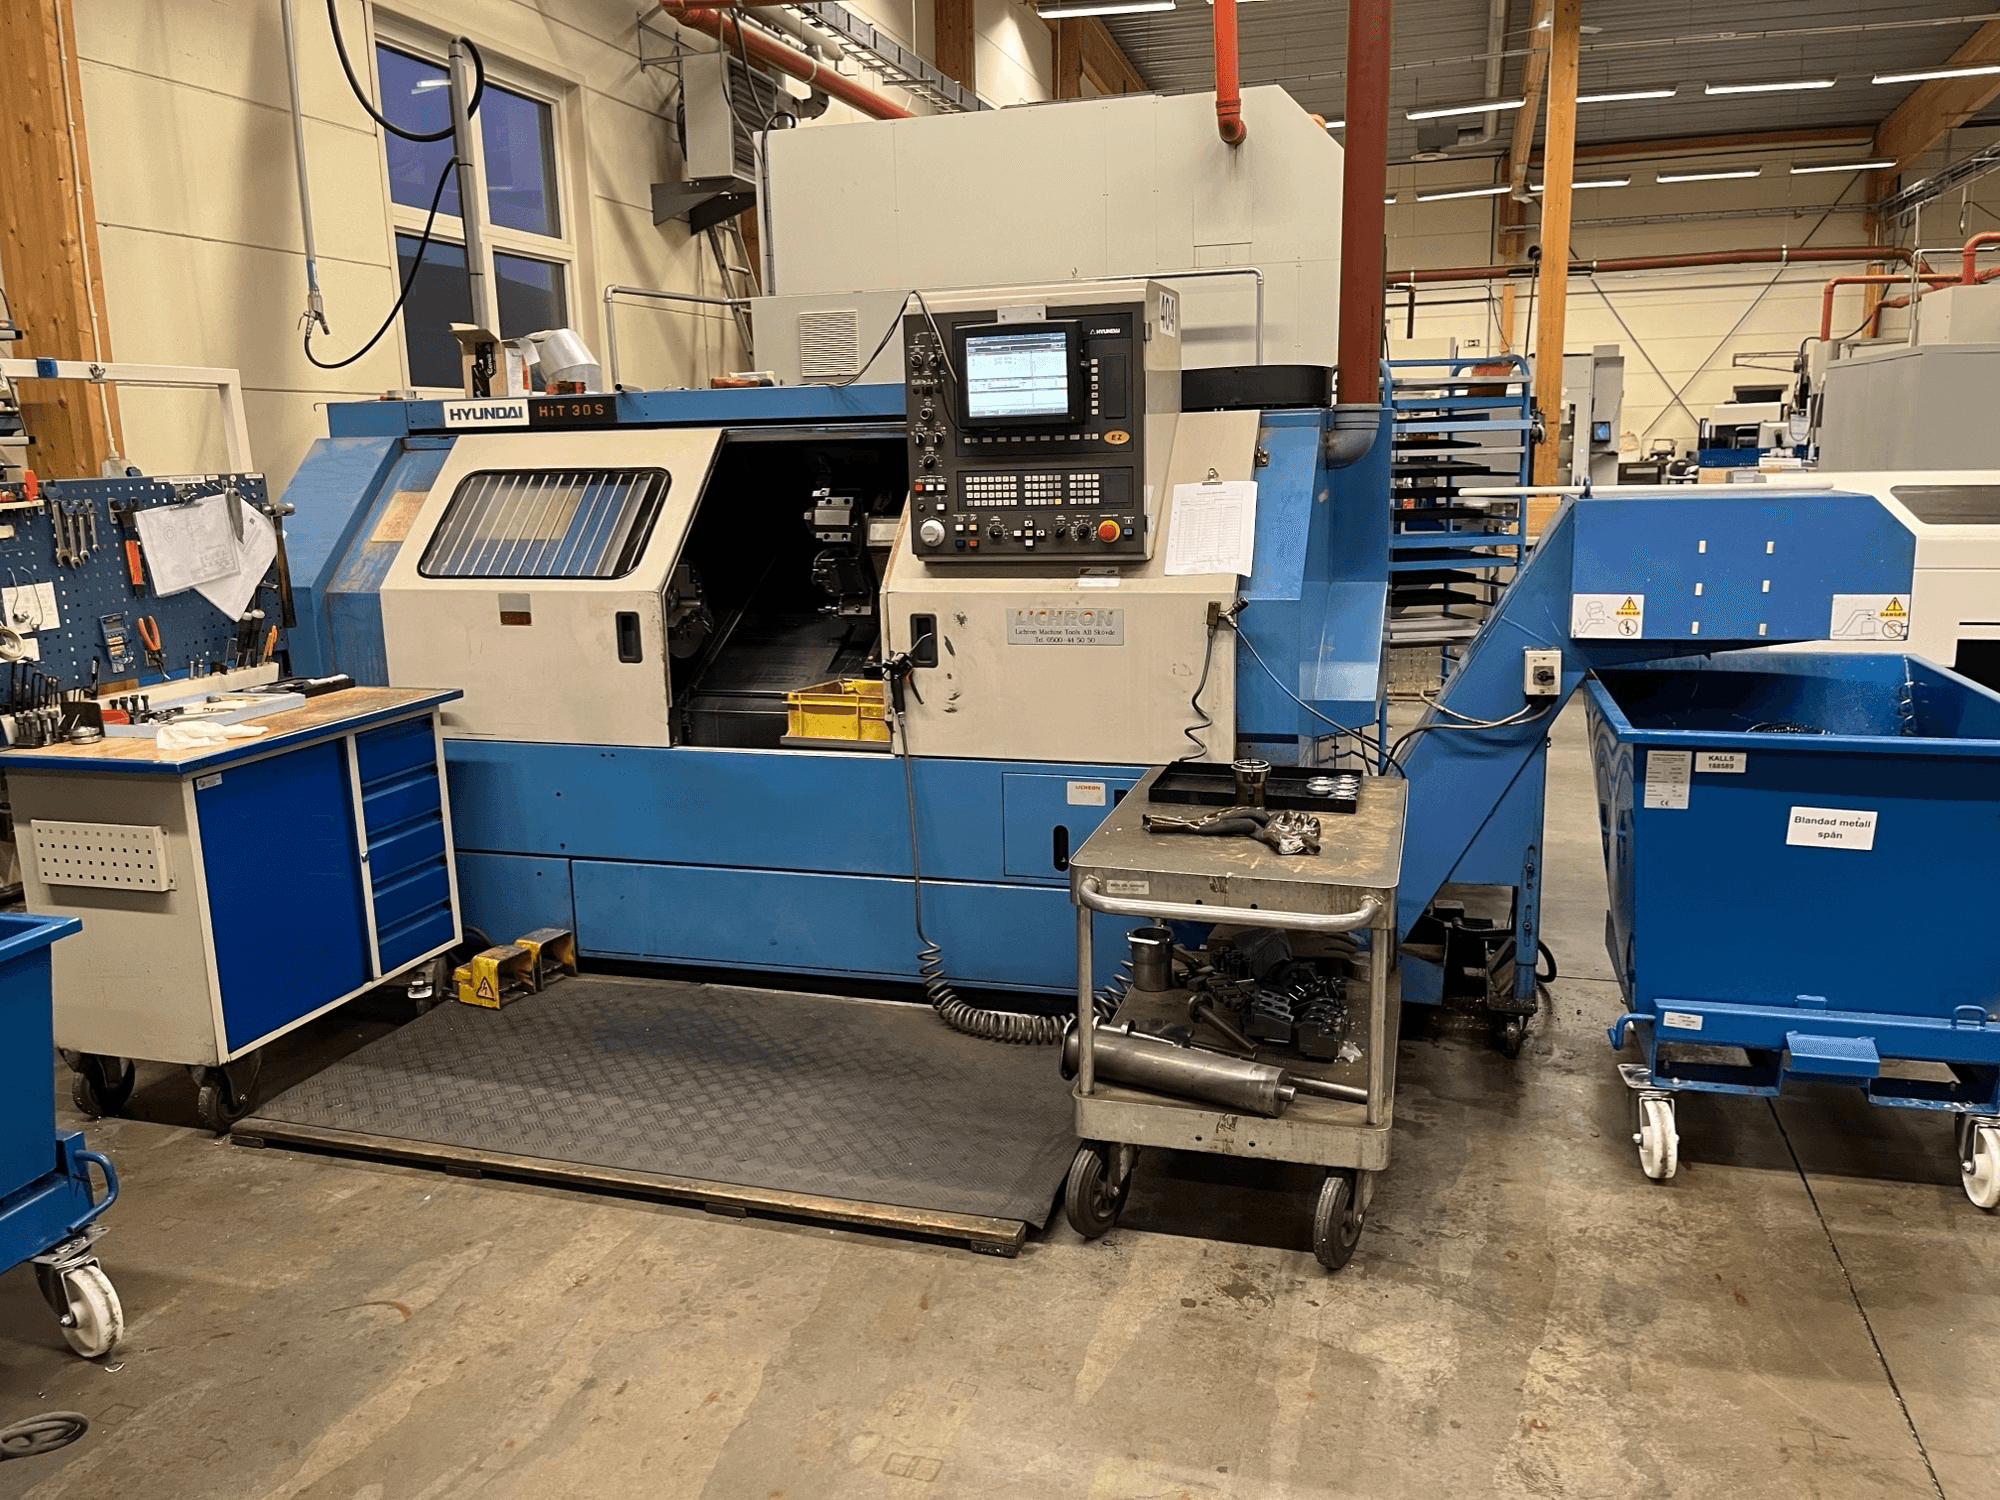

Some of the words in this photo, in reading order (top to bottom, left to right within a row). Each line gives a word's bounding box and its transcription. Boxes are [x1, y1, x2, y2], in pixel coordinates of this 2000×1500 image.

[1160, 295, 1174, 332] 404
[449, 406, 523, 421] HYUNDAI
[539, 405, 565, 417] HiT
[1015, 610, 1114, 627] LICHRON
[1794, 816, 1837, 826] Blandad
[1839, 820, 1871, 828] metall
[1817, 831, 1843, 839] spån
